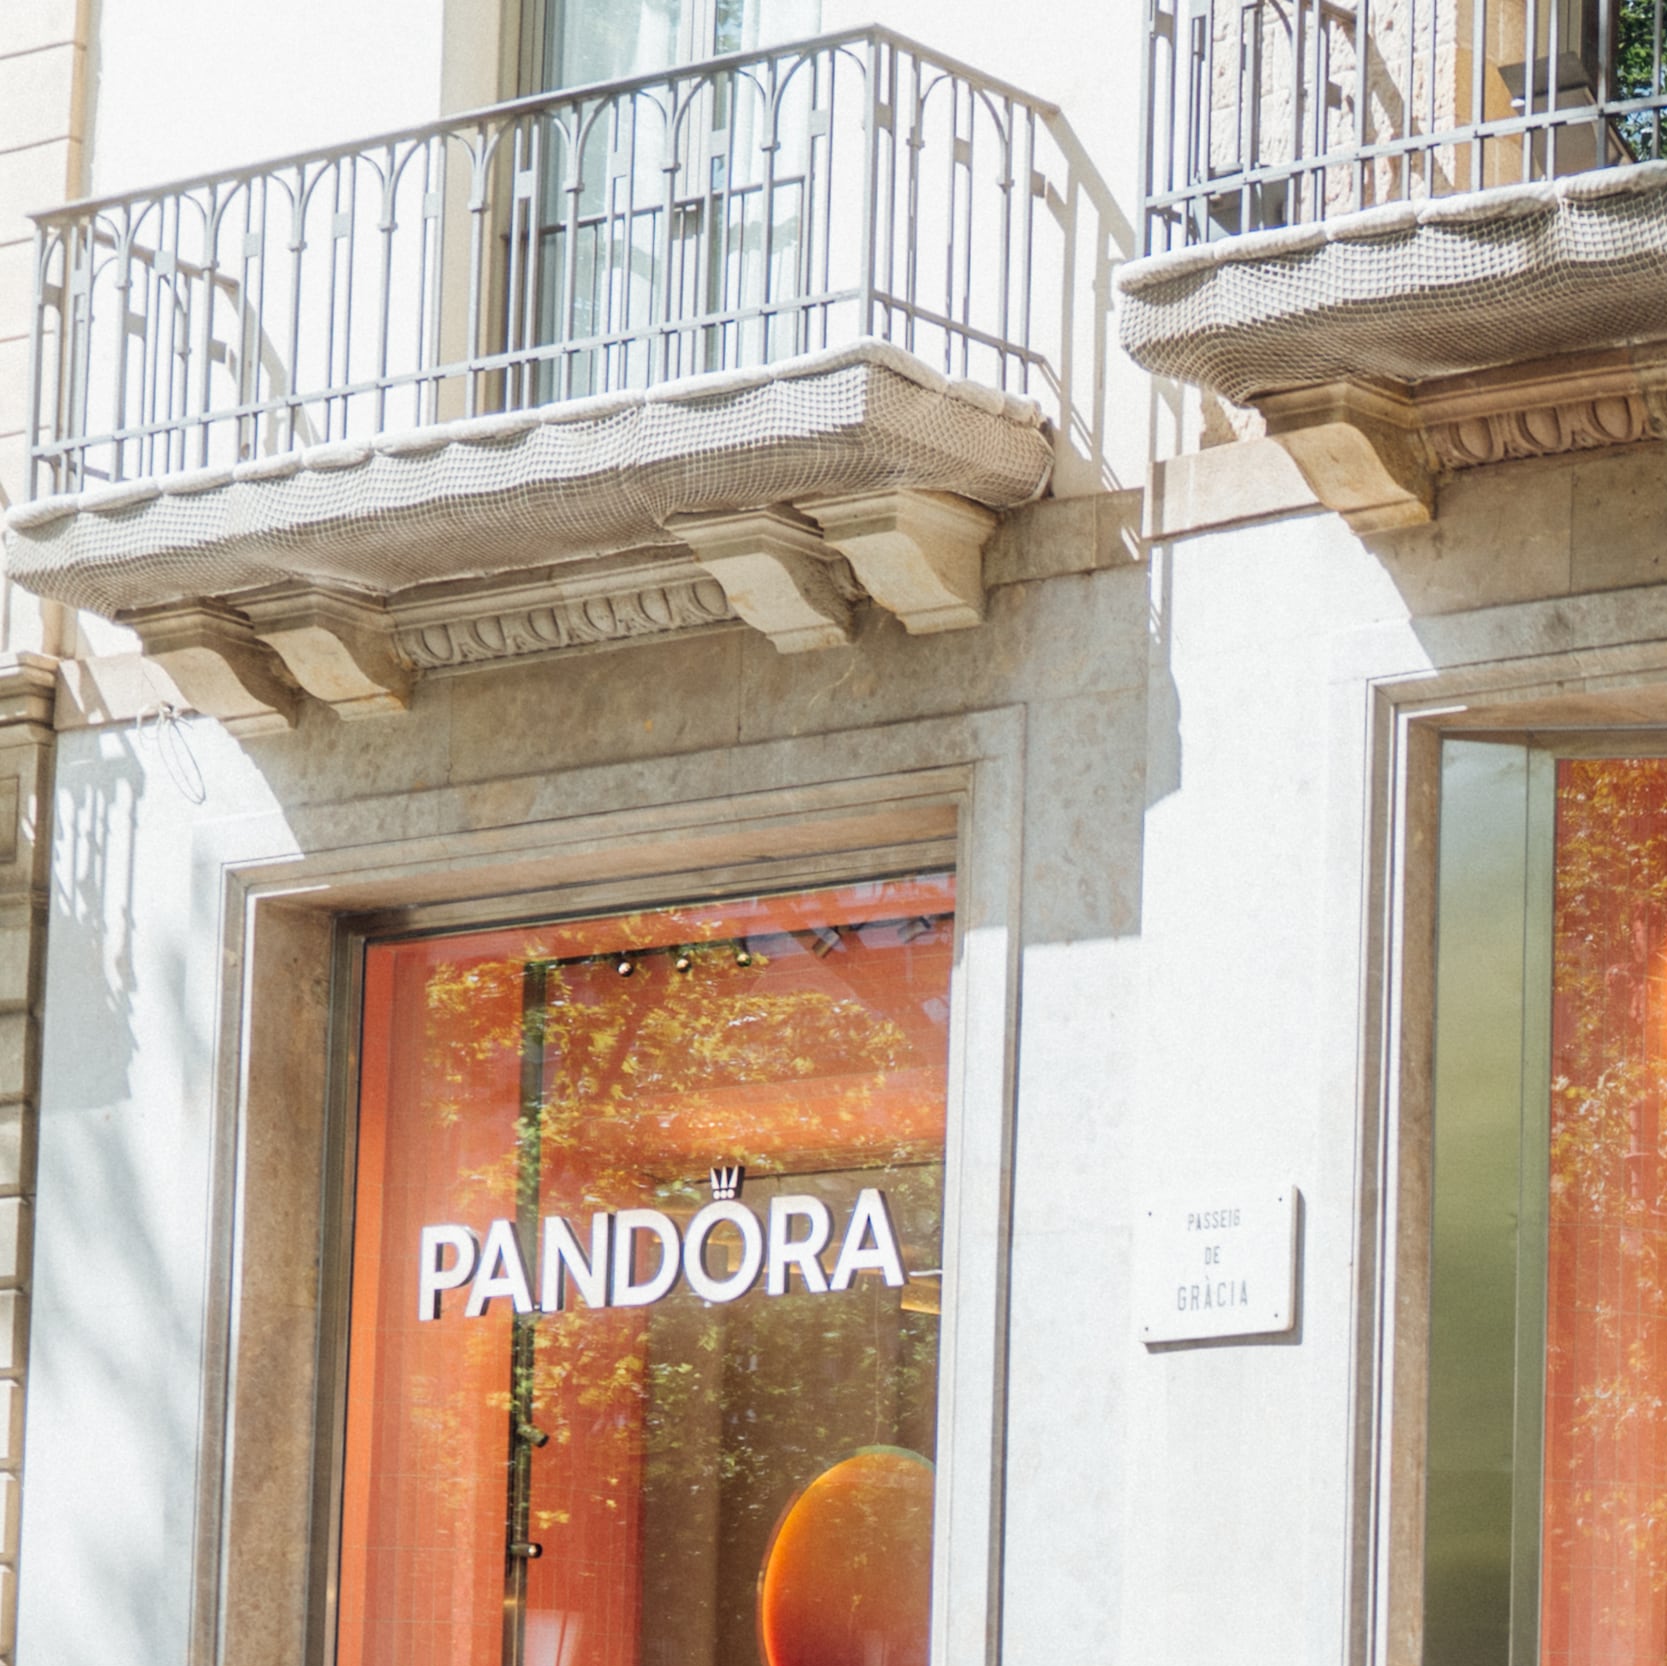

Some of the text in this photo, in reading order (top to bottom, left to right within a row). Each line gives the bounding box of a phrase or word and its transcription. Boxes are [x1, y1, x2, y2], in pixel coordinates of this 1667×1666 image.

[1187, 1209, 1241, 1231] PASSEIG
[417, 1167, 906, 1323] PANDORA
[1204, 1245, 1221, 1265] DE
[1176, 1275, 1249, 1312] GRÀCIA
